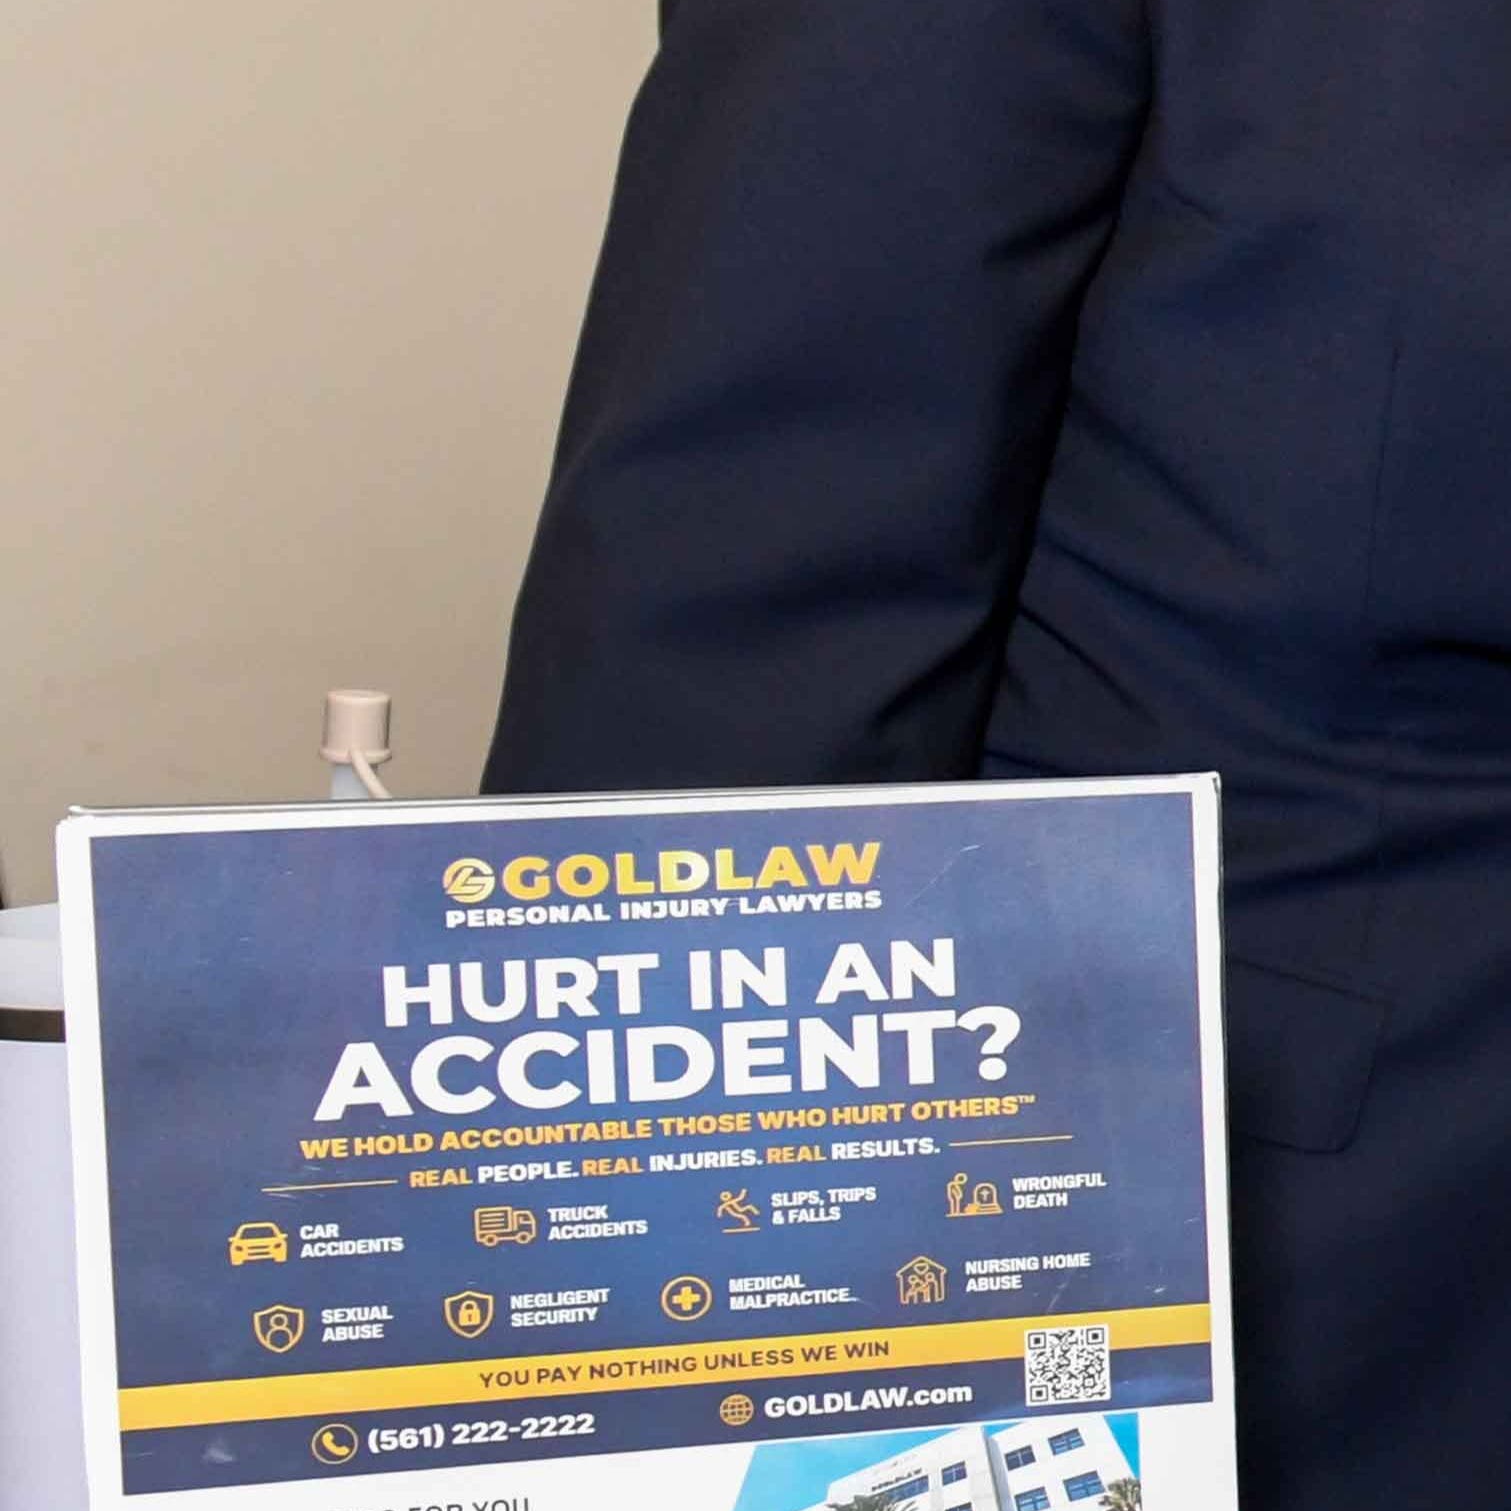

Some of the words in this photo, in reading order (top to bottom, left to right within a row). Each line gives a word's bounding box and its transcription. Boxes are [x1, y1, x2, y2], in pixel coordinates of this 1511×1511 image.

[502, 842, 880, 901] GOLDLAW
[445, 903, 611, 928] PERSONAL
[620, 897, 731, 920] INJURY
[738, 890, 882, 915] LAWYERS
[382, 953, 660, 1027] HURT
[689, 946, 787, 1011] IN
[815, 938, 956, 1004] AN
[313, 1005, 1021, 1122] ACCIDENT?
[300, 1138, 349, 1159] WE
[353, 1132, 434, 1156] HOLD
[439, 1119, 652, 1151] ACCOUNTABLE
[658, 1112, 751, 1136] THOSE
[758, 1108, 827, 1130] WHO
[831, 1102, 905, 1125] HURT
[911, 1095, 1035, 1121] OTHERS™
[409, 1168, 473, 1188] REAL
[477, 1161, 580, 1184] PEOPLE.
[581, 1157, 644, 1176] REAL
[649, 1148, 764, 1172] INJURIES.
[766, 1145, 827, 1164] REAL
[831, 1137, 941, 1160] RESULTS.
[1012, 1172, 1106, 1192] WRONGFUL
[771, 1190, 825, 1209] SLIPS,
[828, 1187, 877, 1205] TRIPS
[1013, 1192, 1068, 1210] DEATH
[547, 1205, 608, 1223] TRUCK
[772, 1209, 784, 1225] &
[787, 1205, 841, 1223] FALLS
[300, 1223, 340, 1241] CAR
[547, 1220, 648, 1241] ACCIDENTS
[300, 1236, 405, 1258] ACCIDENTS
[965, 1257, 1039, 1276] NURSING
[1043, 1253, 1091, 1269] HOME
[729, 1273, 805, 1293] MEDICAL
[965, 1274, 1022, 1293] ABUSE
[510, 1288, 610, 1309] NEGLIGENT
[321, 1305, 393, 1324] SEXUAL
[511, 1307, 598, 1328] SECURITY
[322, 1323, 384, 1343] ABUSE
[479, 1369, 530, 1389] YOU
[536, 1365, 582, 1384] PAY
[589, 1356, 697, 1380] NOTHING
[704, 1348, 795, 1371] UNLESS
[800, 1344, 837, 1363] WE
[843, 1341, 889, 1359] WIN
[764, 1386, 973, 1418] GOLDLAW.com
[367, 1423, 445, 1454] (561)
[451, 1413, 595, 1445] 222-2222
